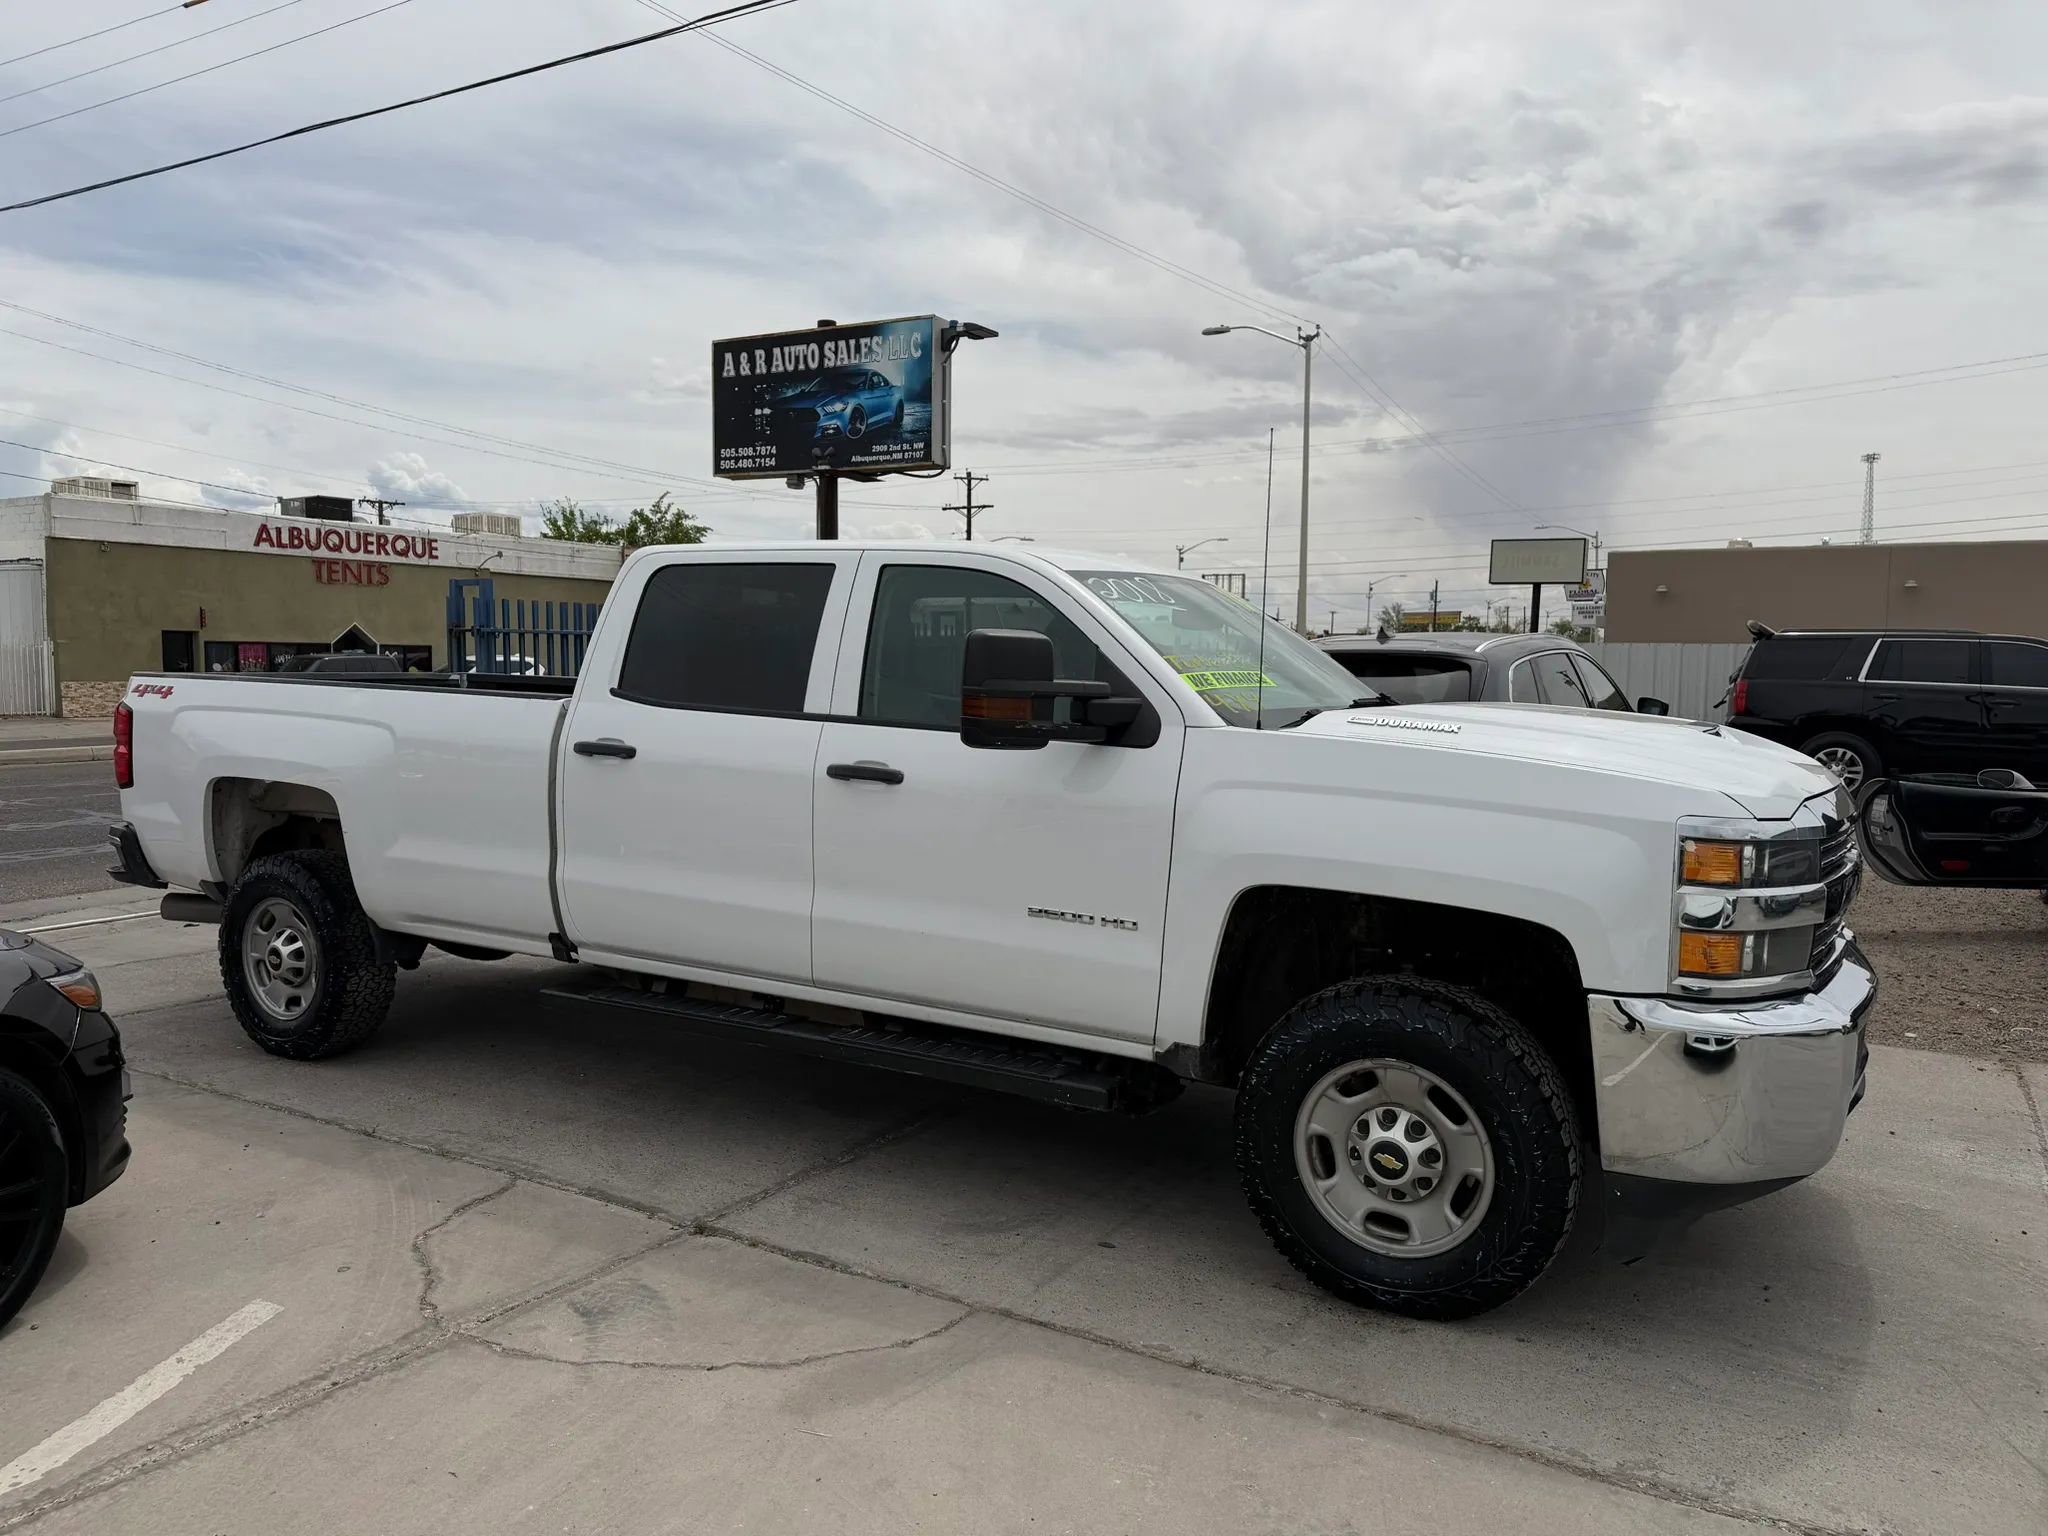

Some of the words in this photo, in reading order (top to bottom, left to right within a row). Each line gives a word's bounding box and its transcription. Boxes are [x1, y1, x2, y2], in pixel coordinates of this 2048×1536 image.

[722, 351, 736, 378] A
[740, 351, 752, 376] &
[754, 348, 767, 375] R
[770, 342, 819, 373] AUTO
[823, 335, 883, 368] SALES
[888, 331, 922, 360] LLC
[889, 443, 901, 451] 2nd
[913, 442, 925, 450] NW
[904, 451, 924, 459] 87107
[720, 457, 776, 469] 505.480.7154
[253, 523, 439, 560] ALBUQUERQUE
[312, 559, 390, 587] TENTS
[1187, 673, 1215, 689] WE
[1211, 671, 1269, 687] FINANCE
[1377, 717, 1462, 734] DURAMAX
[1027, 905, 1095, 925] 2500
[1100, 915, 1138, 931] HD
